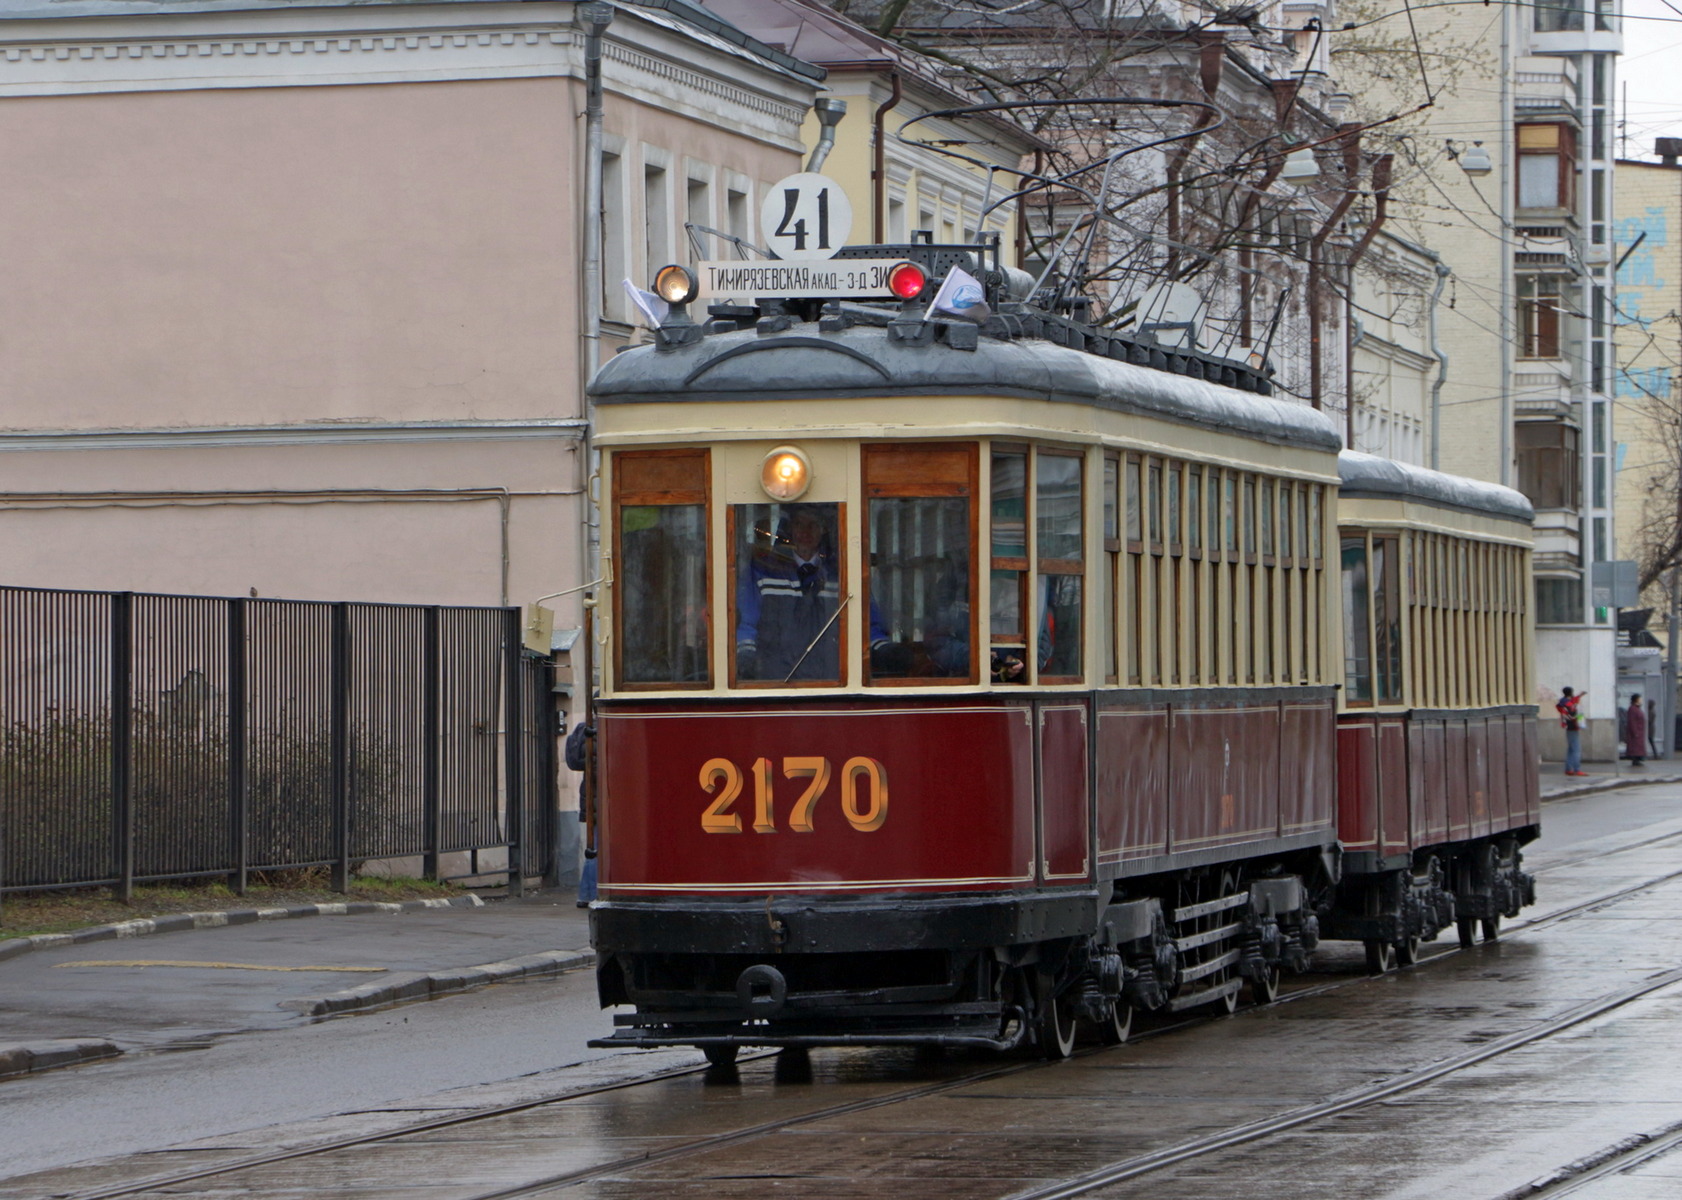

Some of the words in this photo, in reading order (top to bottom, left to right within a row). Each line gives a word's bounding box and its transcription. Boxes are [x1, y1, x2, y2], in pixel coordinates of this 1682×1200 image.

[774, 187, 832, 251] 41
[708, 266, 809, 291] ТИМИРЯЗЕВСКАЯ
[870, 265, 889, 289] ЗИ
[698, 756, 889, 834] 2170
